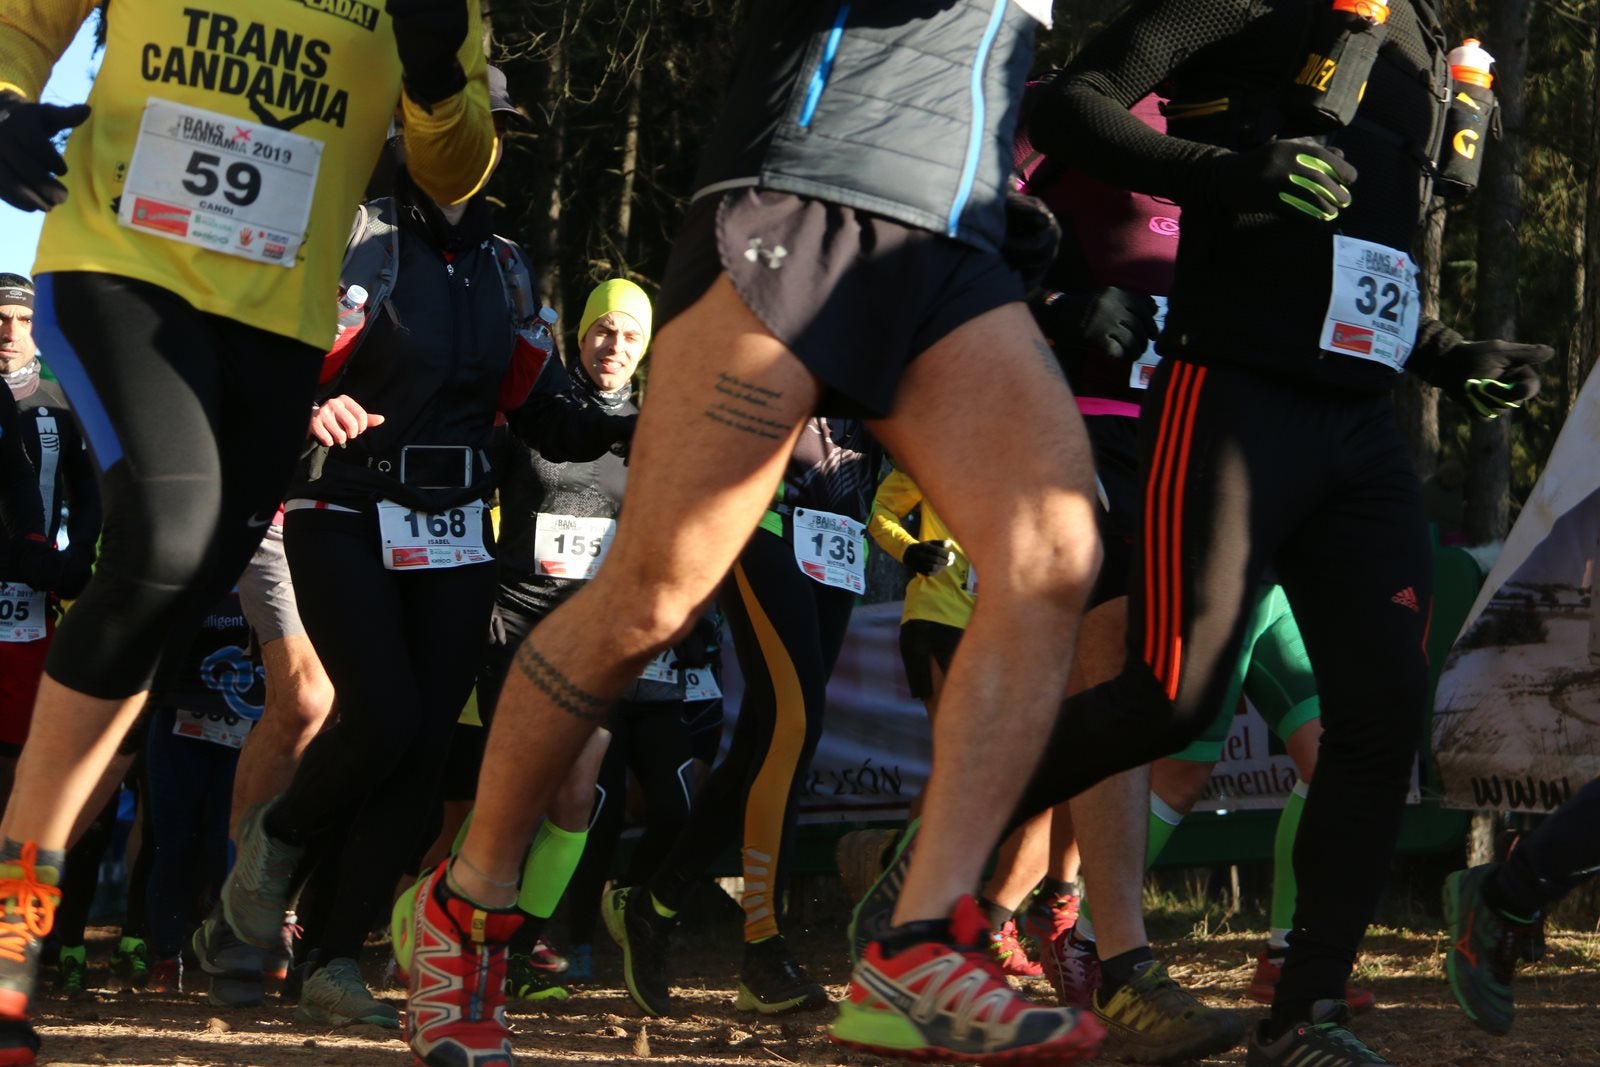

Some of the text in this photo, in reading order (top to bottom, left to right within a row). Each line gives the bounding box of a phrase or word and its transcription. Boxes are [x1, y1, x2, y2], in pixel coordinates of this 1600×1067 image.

[183, 7, 331, 79] TRANS
[141, 43, 349, 128] CANDAMIA
[253, 141, 292, 165] 2019
[181, 150, 262, 207] 59
[199, 199, 234, 216] CANDI
[1355, 275, 1408, 326] 32
[404, 508, 466, 538] 168
[553, 533, 602, 558] 155
[811, 532, 856, 565] 135
[203, 613, 244, 630] lligent
[687, 672, 699, 686] 0
